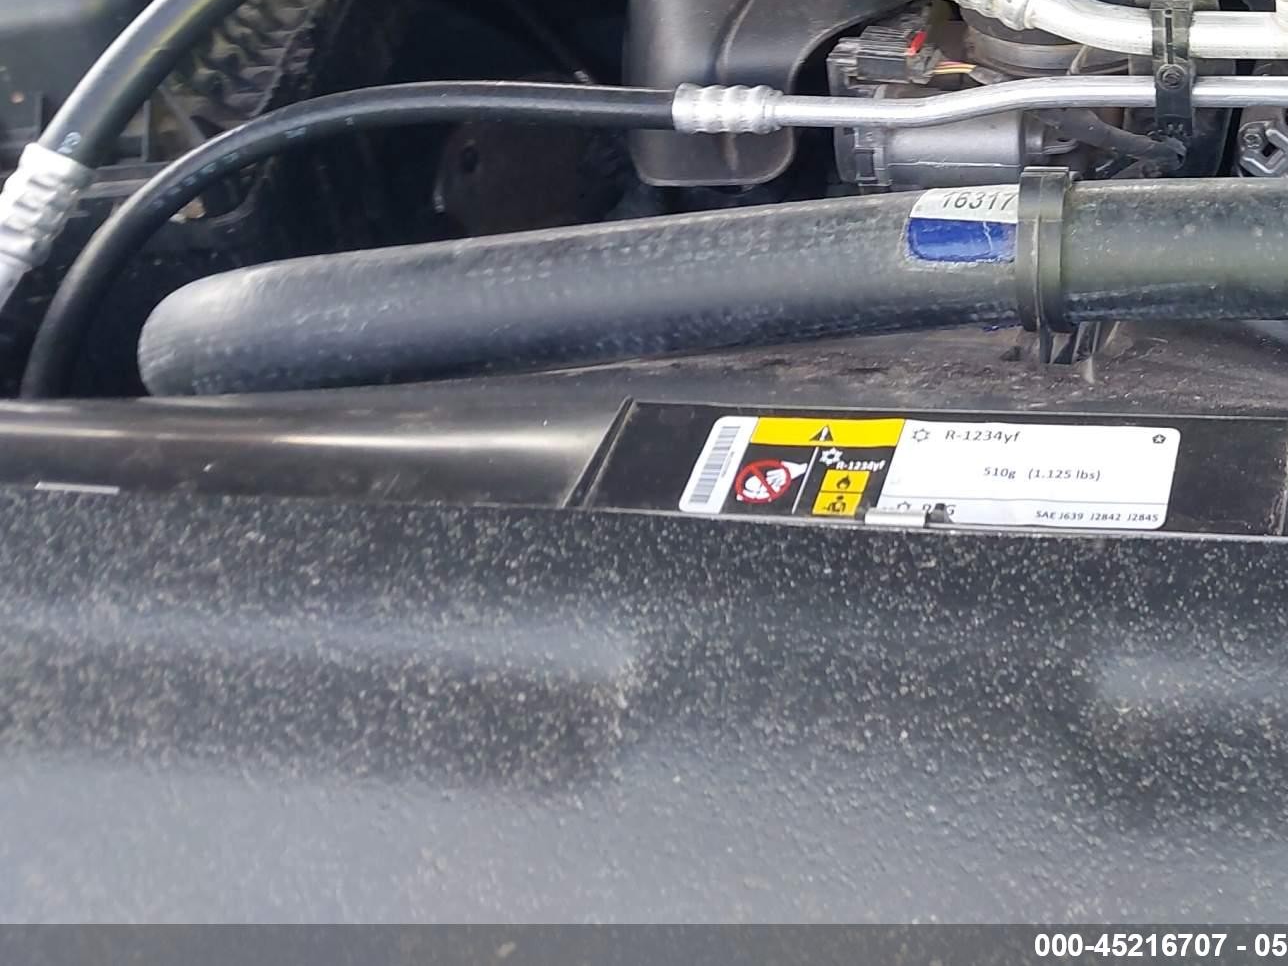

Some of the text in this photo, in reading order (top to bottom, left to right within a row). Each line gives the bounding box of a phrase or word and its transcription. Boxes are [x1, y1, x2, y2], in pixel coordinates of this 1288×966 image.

[942, 191, 1019, 211] 16317
[944, 429, 1021, 444] R-1234yf
[983, 466, 1102, 482] 510g (1.125 lbs)
